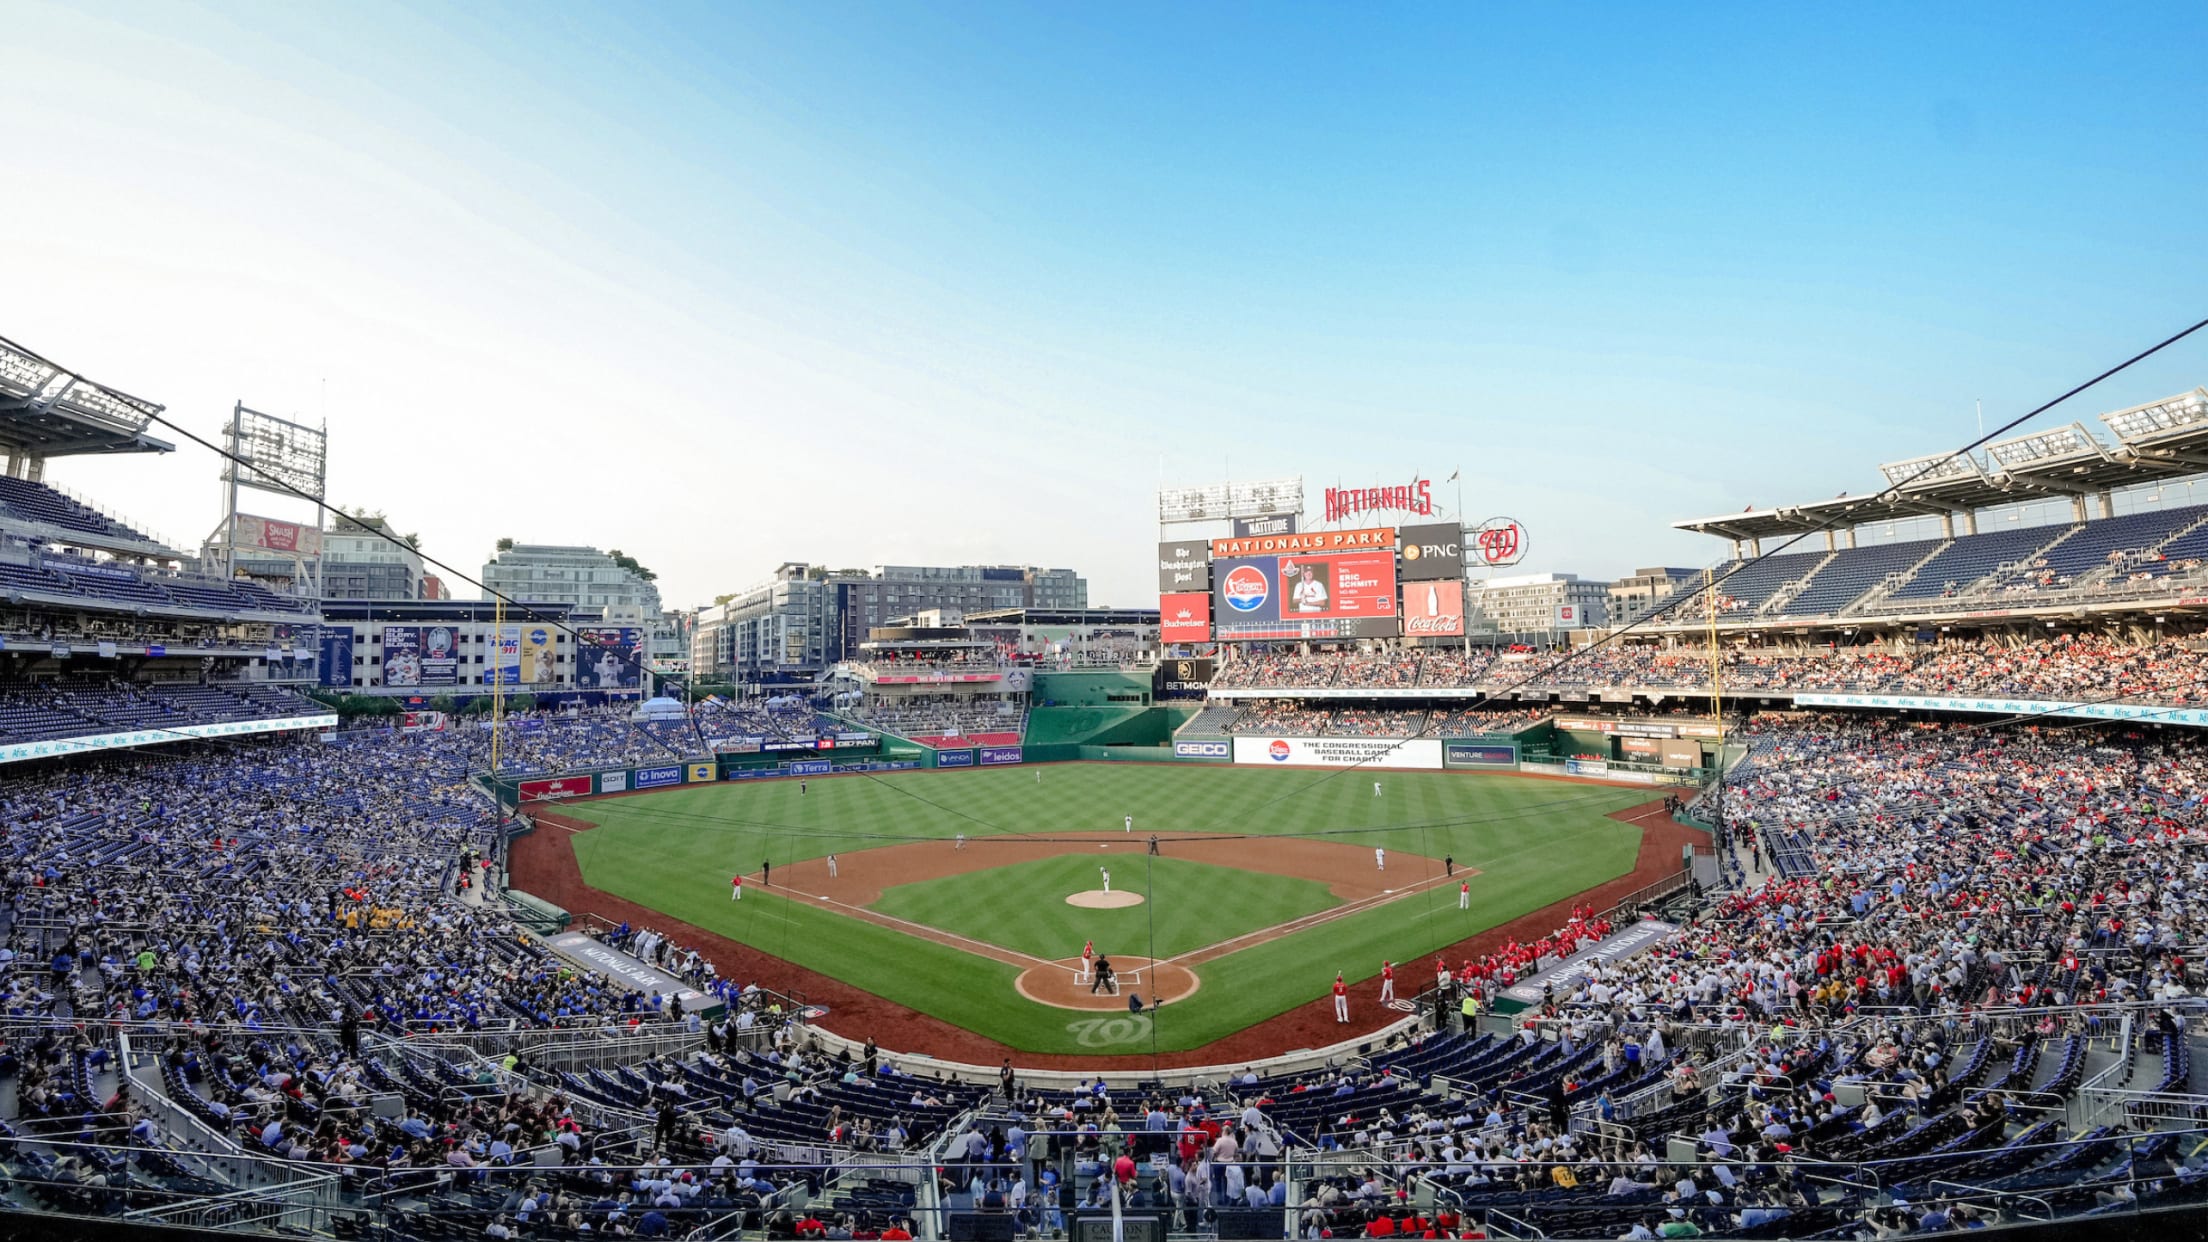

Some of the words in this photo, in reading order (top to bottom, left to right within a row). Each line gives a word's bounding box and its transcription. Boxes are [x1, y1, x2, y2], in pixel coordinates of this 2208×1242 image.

[1325, 480, 1431, 521] NATIONALS
[1249, 519, 1289, 534] NATITUDE
[1218, 537, 1325, 553] NATIONALS
[1333, 532, 1385, 545] PARK
[1421, 543, 1458, 557] PNC
[1339, 579, 1378, 588] SCHMITT
[1163, 619, 1206, 629] Budweiser
[1407, 614, 1460, 633] Coca-Cola
[1166, 681, 1209, 691] BETMGM
[1176, 743, 1228, 755] GEICO
[1322, 742, 1403, 750] CONGRESSIONAL
[993, 751, 1020, 761] leidos
[1451, 751, 1483, 759] VENTURE
[803, 764, 829, 773] Terra
[650, 769, 678, 780] Inova
[583, 947, 636, 978] NATIONALS
[627, 969, 666, 987] PARK
